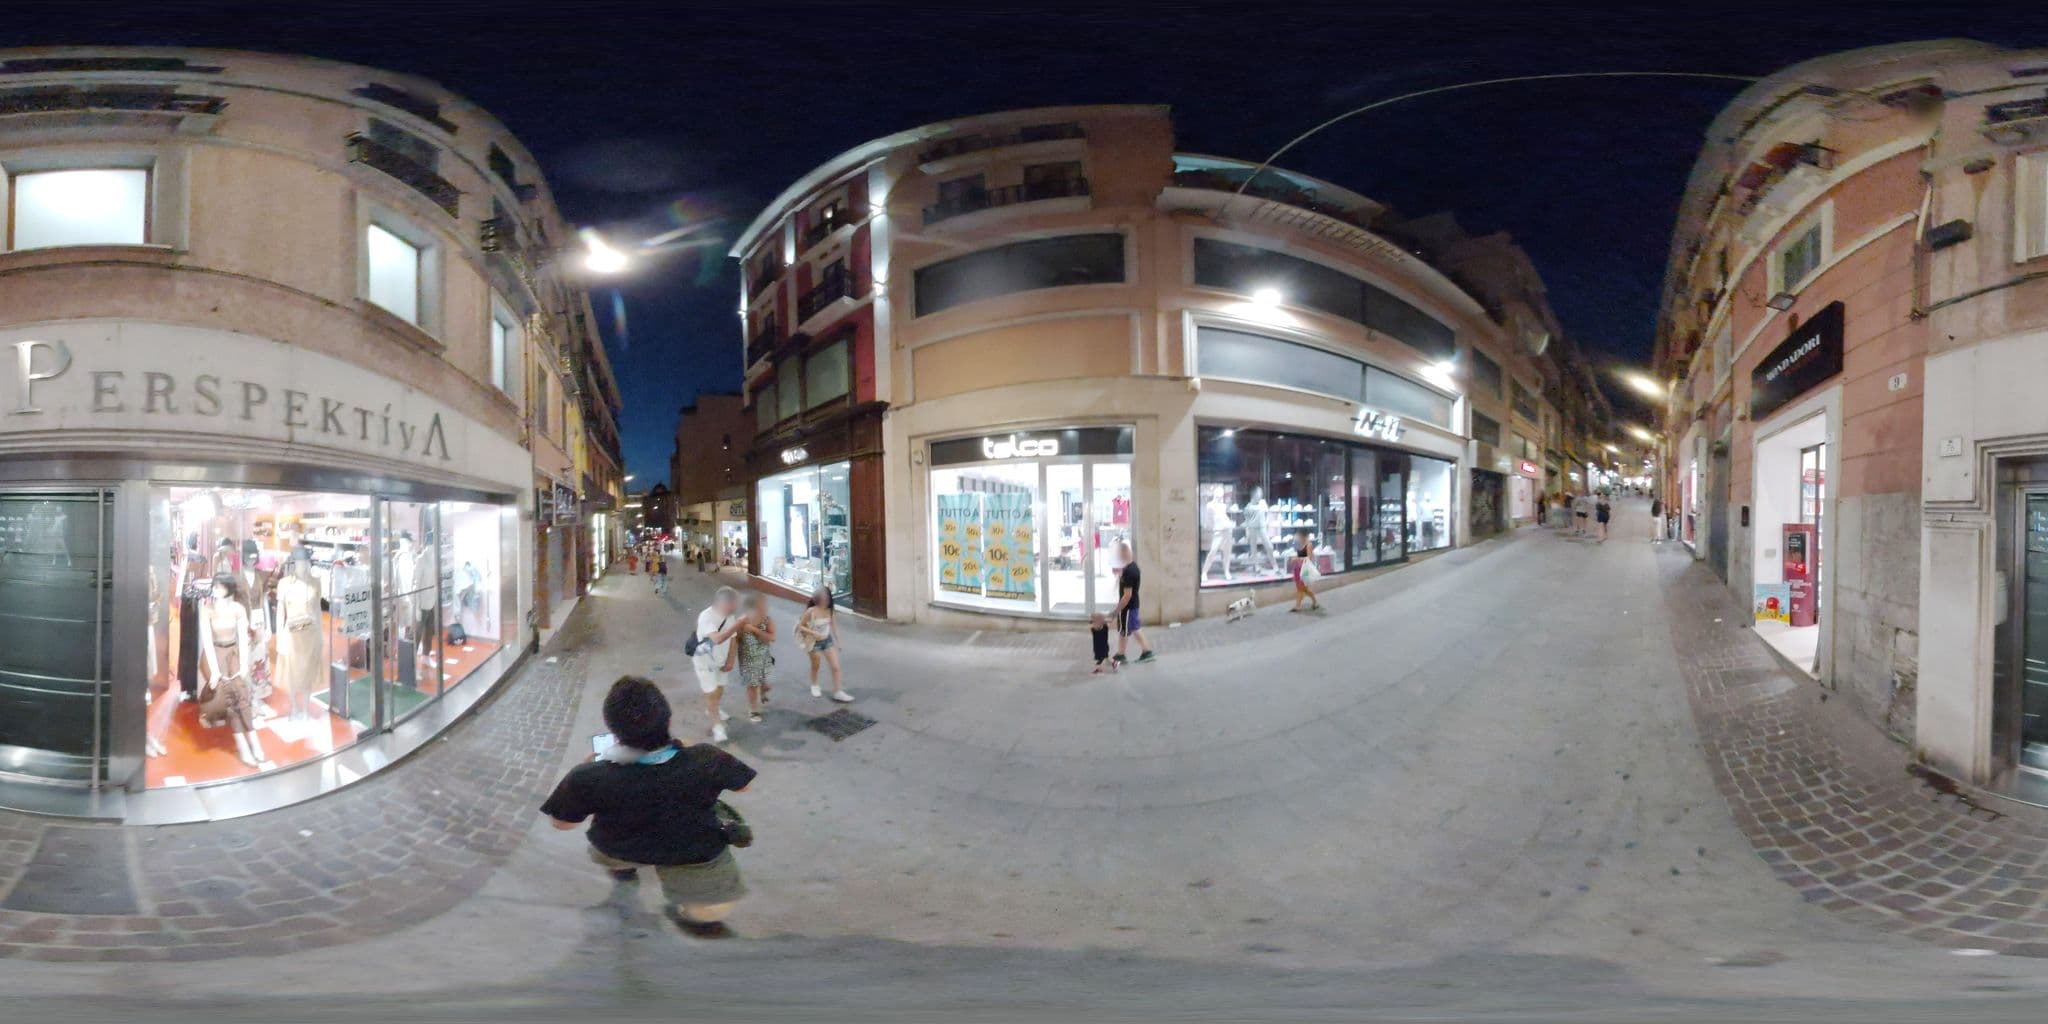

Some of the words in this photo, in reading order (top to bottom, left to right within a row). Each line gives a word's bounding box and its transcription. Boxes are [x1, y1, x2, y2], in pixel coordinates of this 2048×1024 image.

[1766, 334, 1820, 381] MONDADORI
[983, 434, 1058, 459] telco
[941, 508, 970, 518] TUTTO
[987, 509, 1020, 519] TUTTO
[344, 590, 370, 605] SALDI
